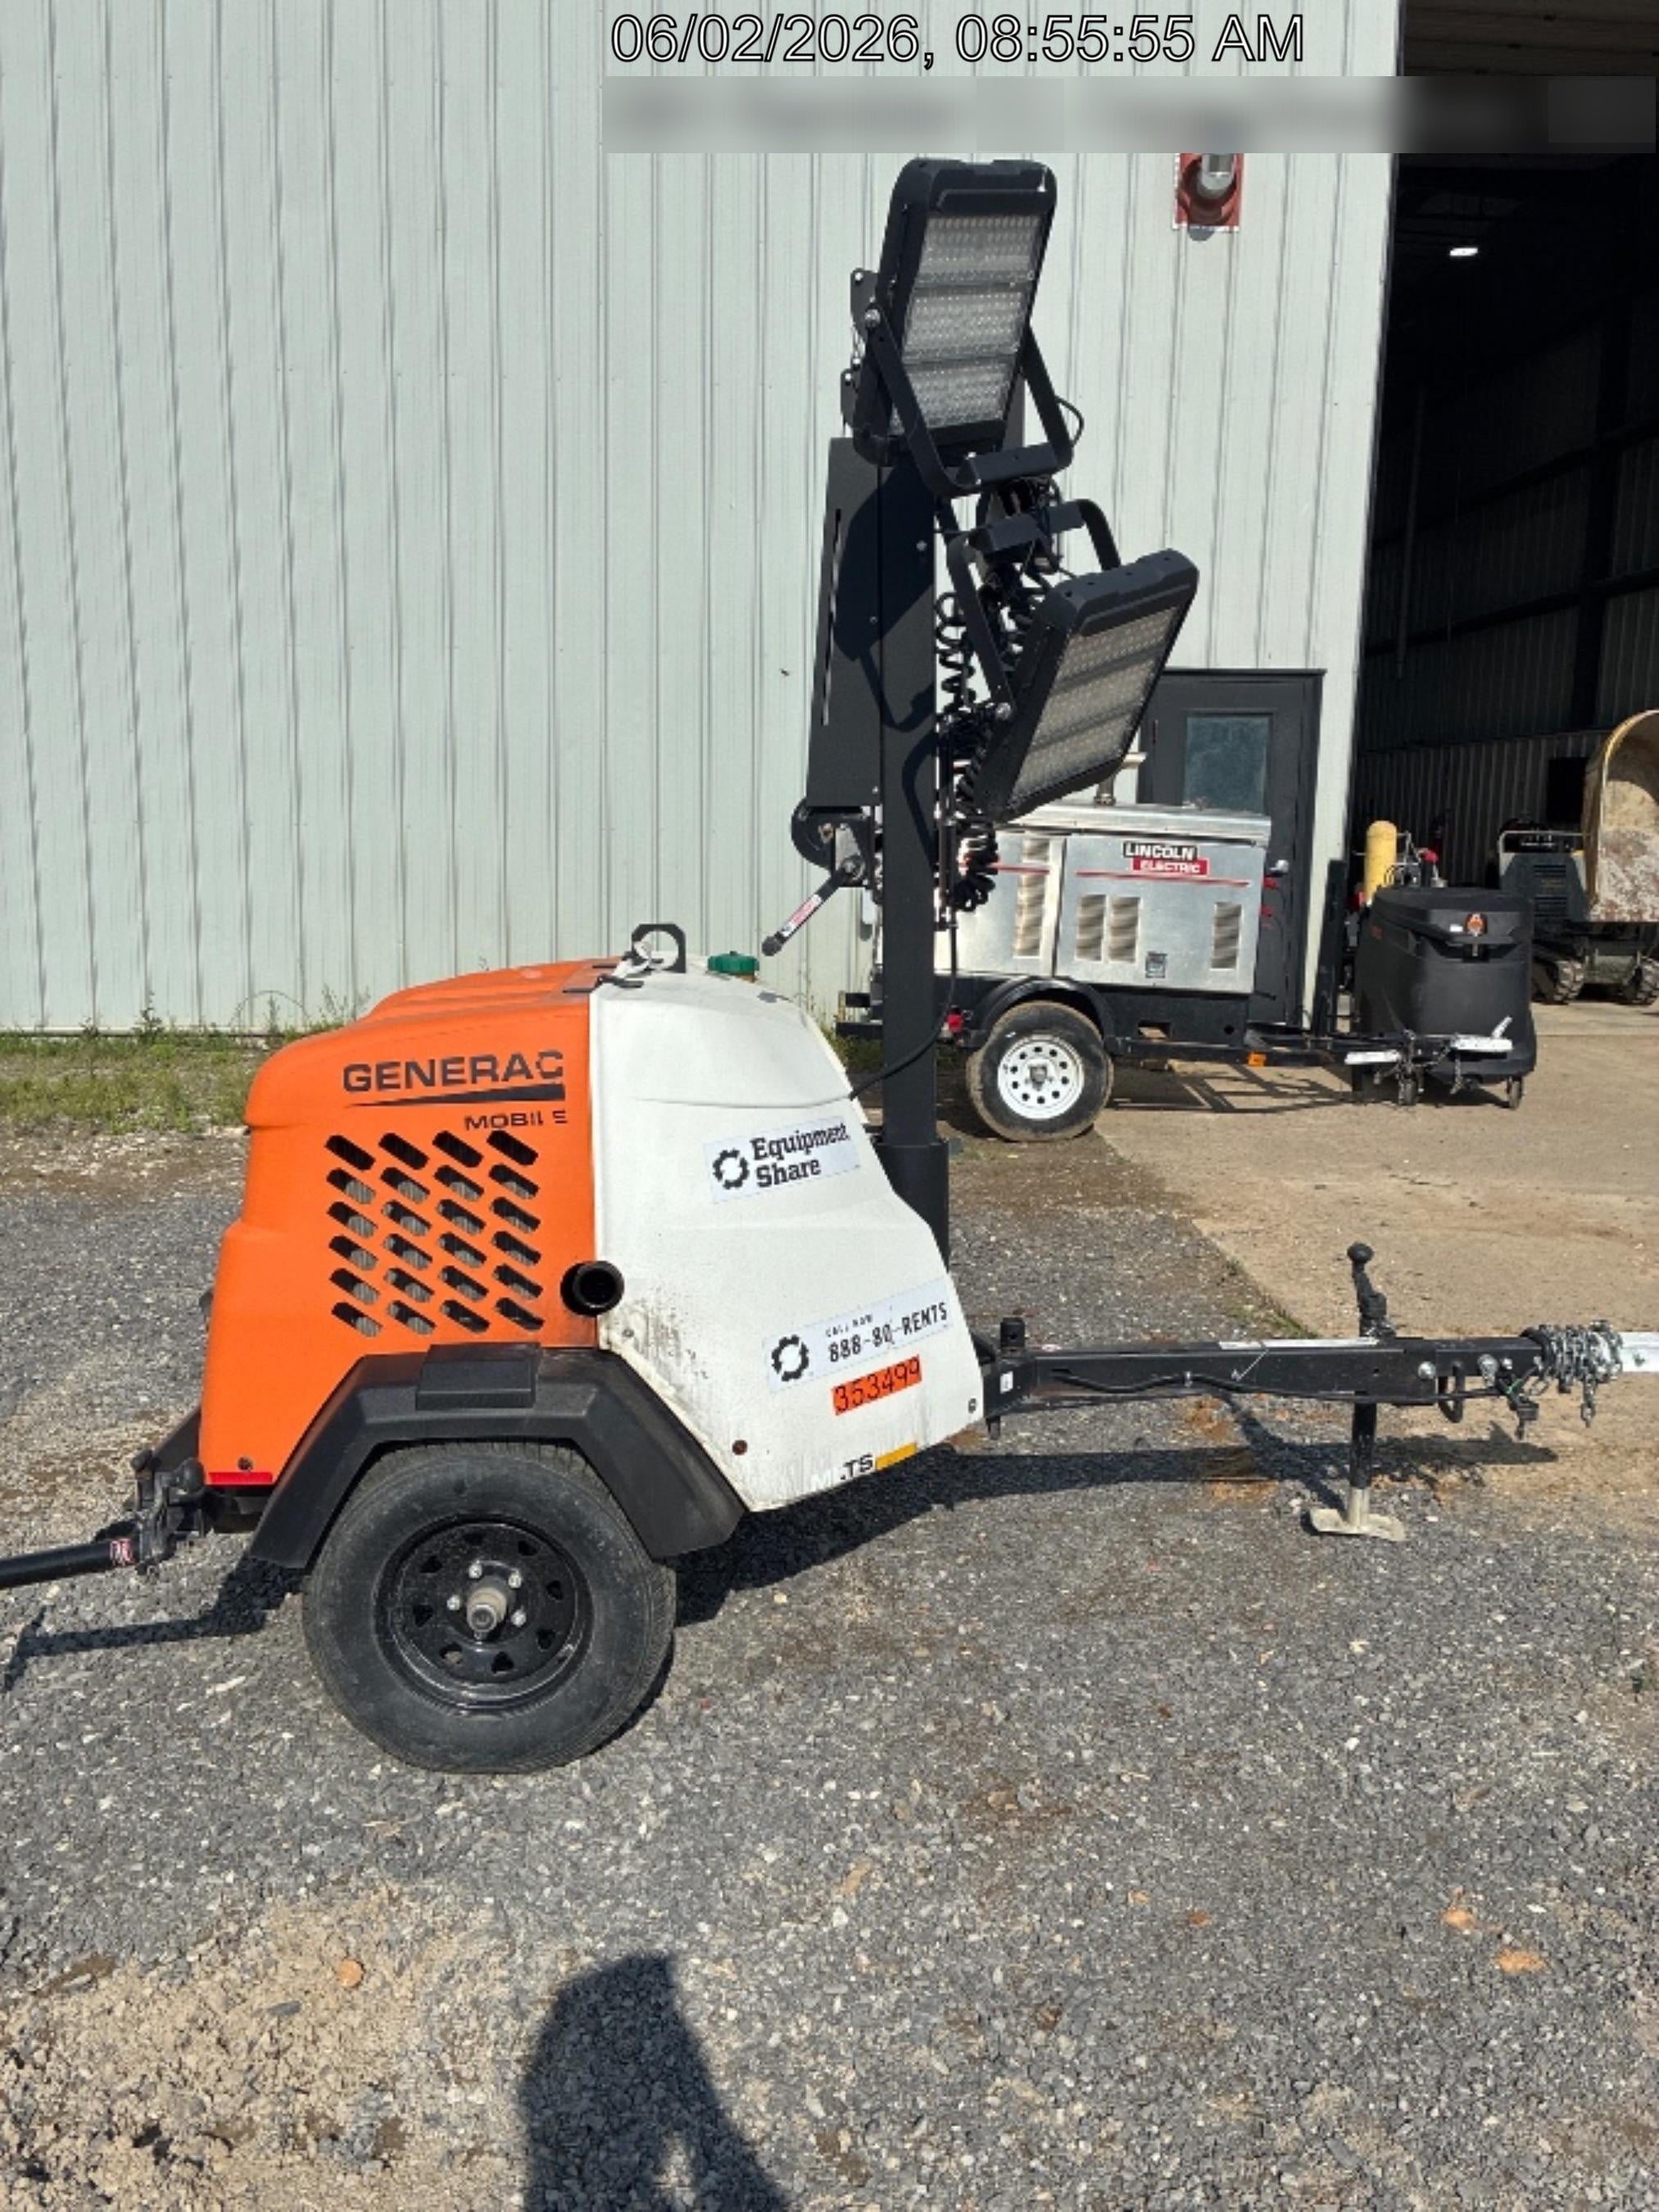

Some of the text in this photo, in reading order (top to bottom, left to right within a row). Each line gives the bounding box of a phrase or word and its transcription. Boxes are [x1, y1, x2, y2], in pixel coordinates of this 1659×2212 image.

[1126, 841, 1194, 861] LINCOLN
[342, 1049, 564, 1092] GENERAC
[750, 1122, 850, 1160] Equipment
[755, 1158, 822, 1188] Share
[834, 1356, 920, 1412] 353499
[840, 1453, 873, 1480] TS
